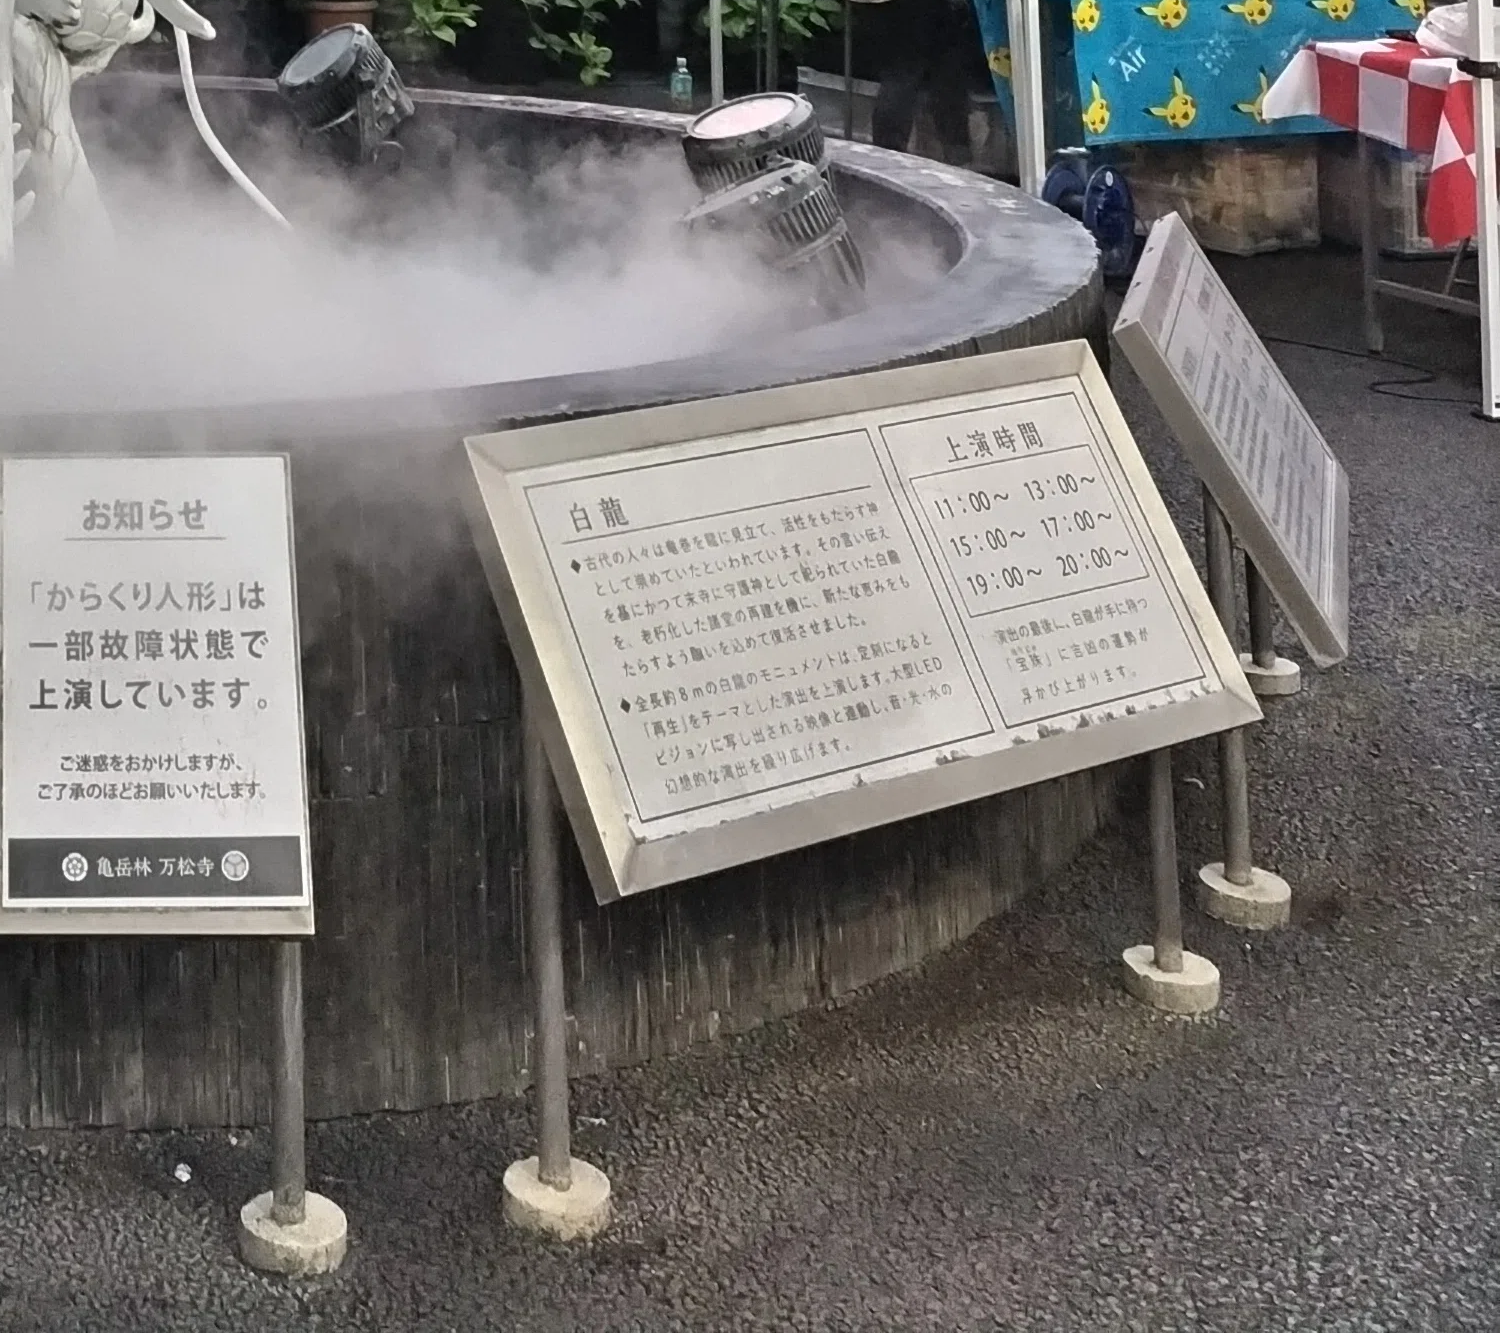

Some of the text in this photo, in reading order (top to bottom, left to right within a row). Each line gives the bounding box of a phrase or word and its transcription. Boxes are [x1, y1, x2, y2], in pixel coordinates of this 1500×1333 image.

[945, 420, 1045, 464] 上演時間
[82, 498, 209, 532] お知らせ
[569, 496, 630, 533] 白龍
[29, 580, 267, 614] 「からくり人形」は
[27, 628, 270, 663] 一部故障状態で
[27, 678, 271, 713] 上演しています。
[58, 752, 244, 774] ご迷惑をおかけしますが、
[37, 780, 267, 802] ご了承のほどお願いいたします。
[96, 855, 215, 878] 亀岳林 万松寺
